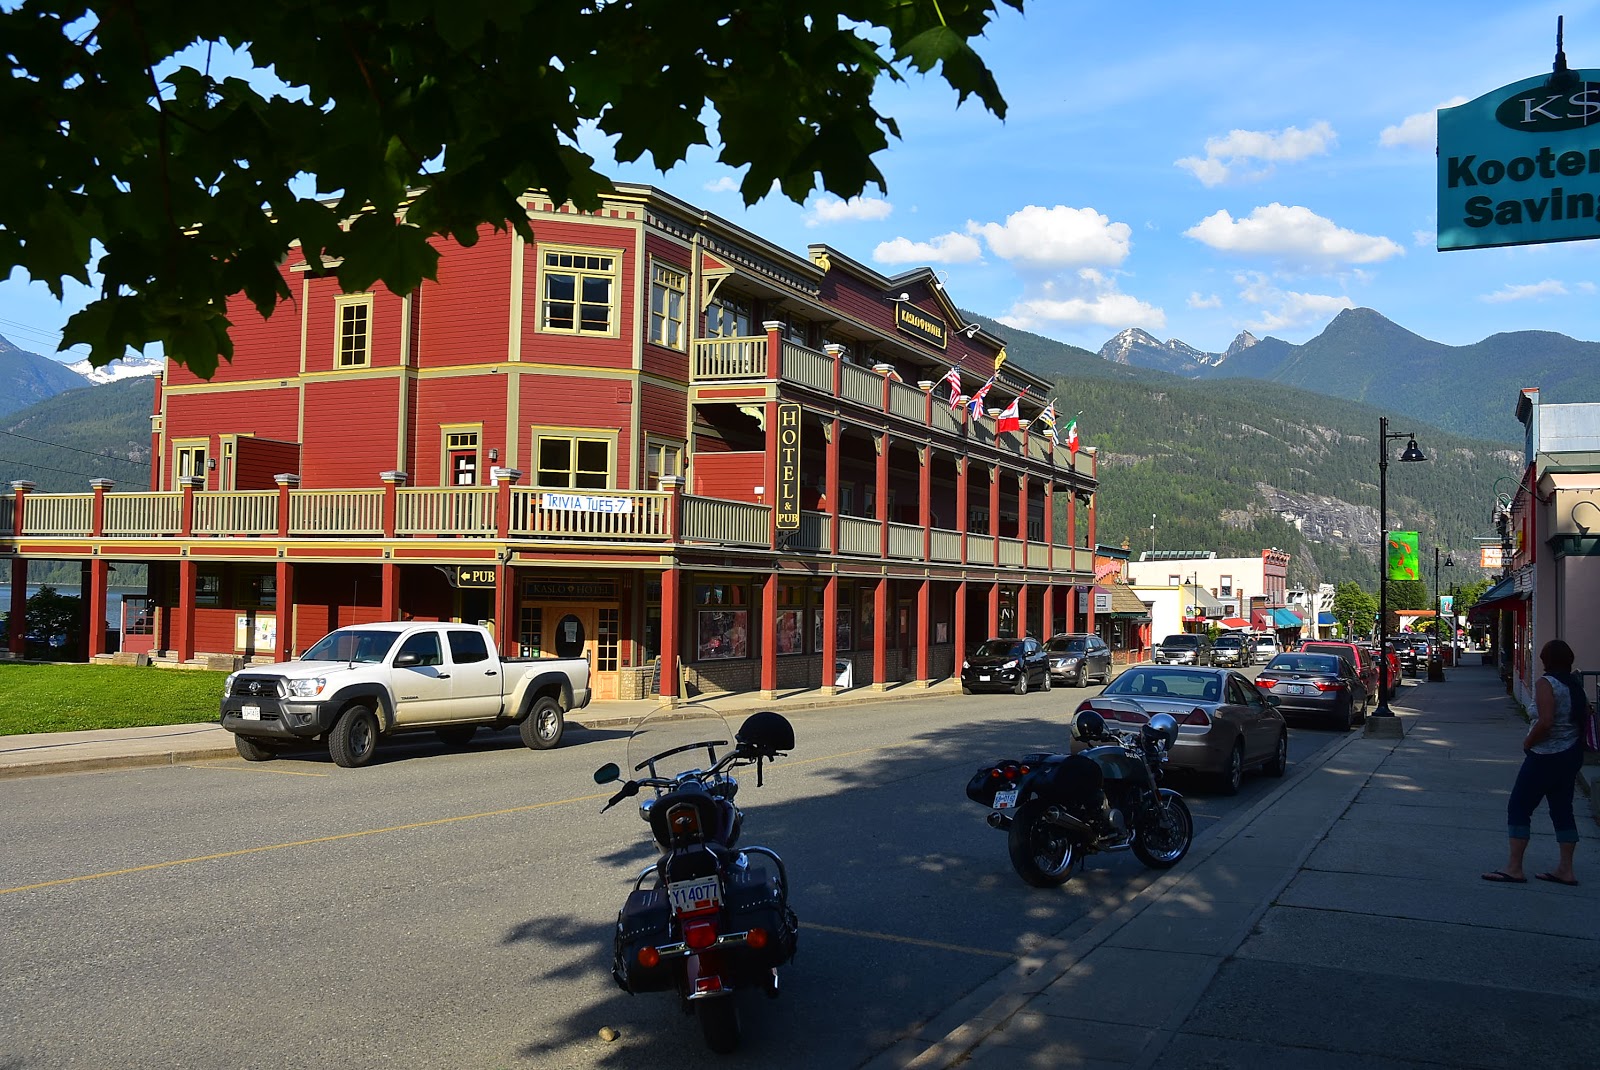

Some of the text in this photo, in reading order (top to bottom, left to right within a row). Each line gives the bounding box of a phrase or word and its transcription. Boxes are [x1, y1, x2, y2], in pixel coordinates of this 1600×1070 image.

[1463, 187, 1600, 228] Savin
[782, 411, 797, 499] HOTEL
[546, 494, 582, 509] TRIVIA
[784, 501, 792, 511] &
[778, 513, 799, 523] PUB
[472, 570, 495, 582] PUB
[533, 584, 609, 595] KASLO HOTEL
[672, 883, 717, 904] Y14077
